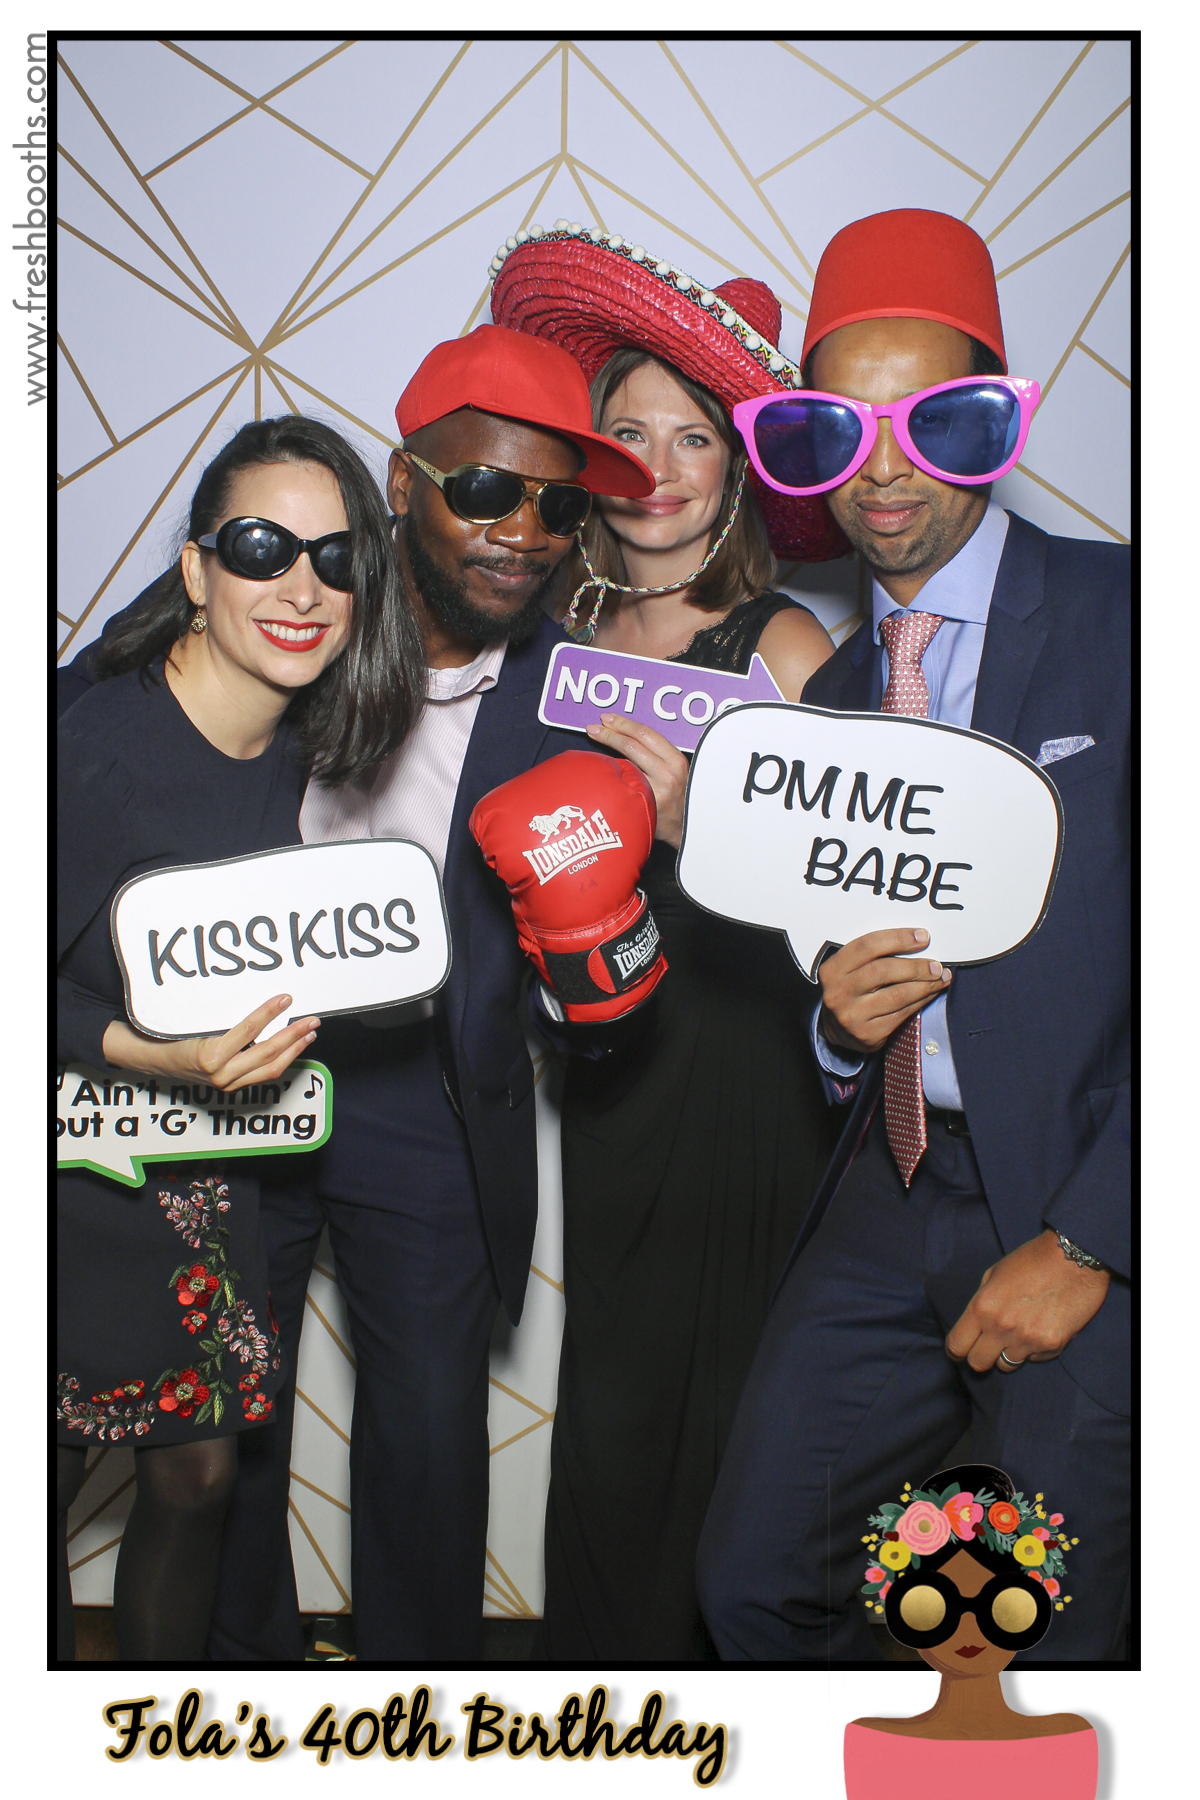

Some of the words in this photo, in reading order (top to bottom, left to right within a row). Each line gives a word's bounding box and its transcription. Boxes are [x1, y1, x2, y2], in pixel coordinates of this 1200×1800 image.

[555, 666, 645, 714] NOT
[653, 685, 744, 726] CO
[742, 752, 842, 819] PM
[846, 772, 944, 835] ME
[522, 809, 623, 886] LONSDALE
[567, 854, 599, 875] LONDON
[803, 837, 973, 911] BABE
[148, 915, 283, 986] KISS
[289, 898, 420, 968] KISS
[71, 1079, 160, 1106] Ain't
[115, 1116, 139, 1137] a
[150, 1109, 197, 1136] 'G'
[208, 1109, 316, 1140] Thang
